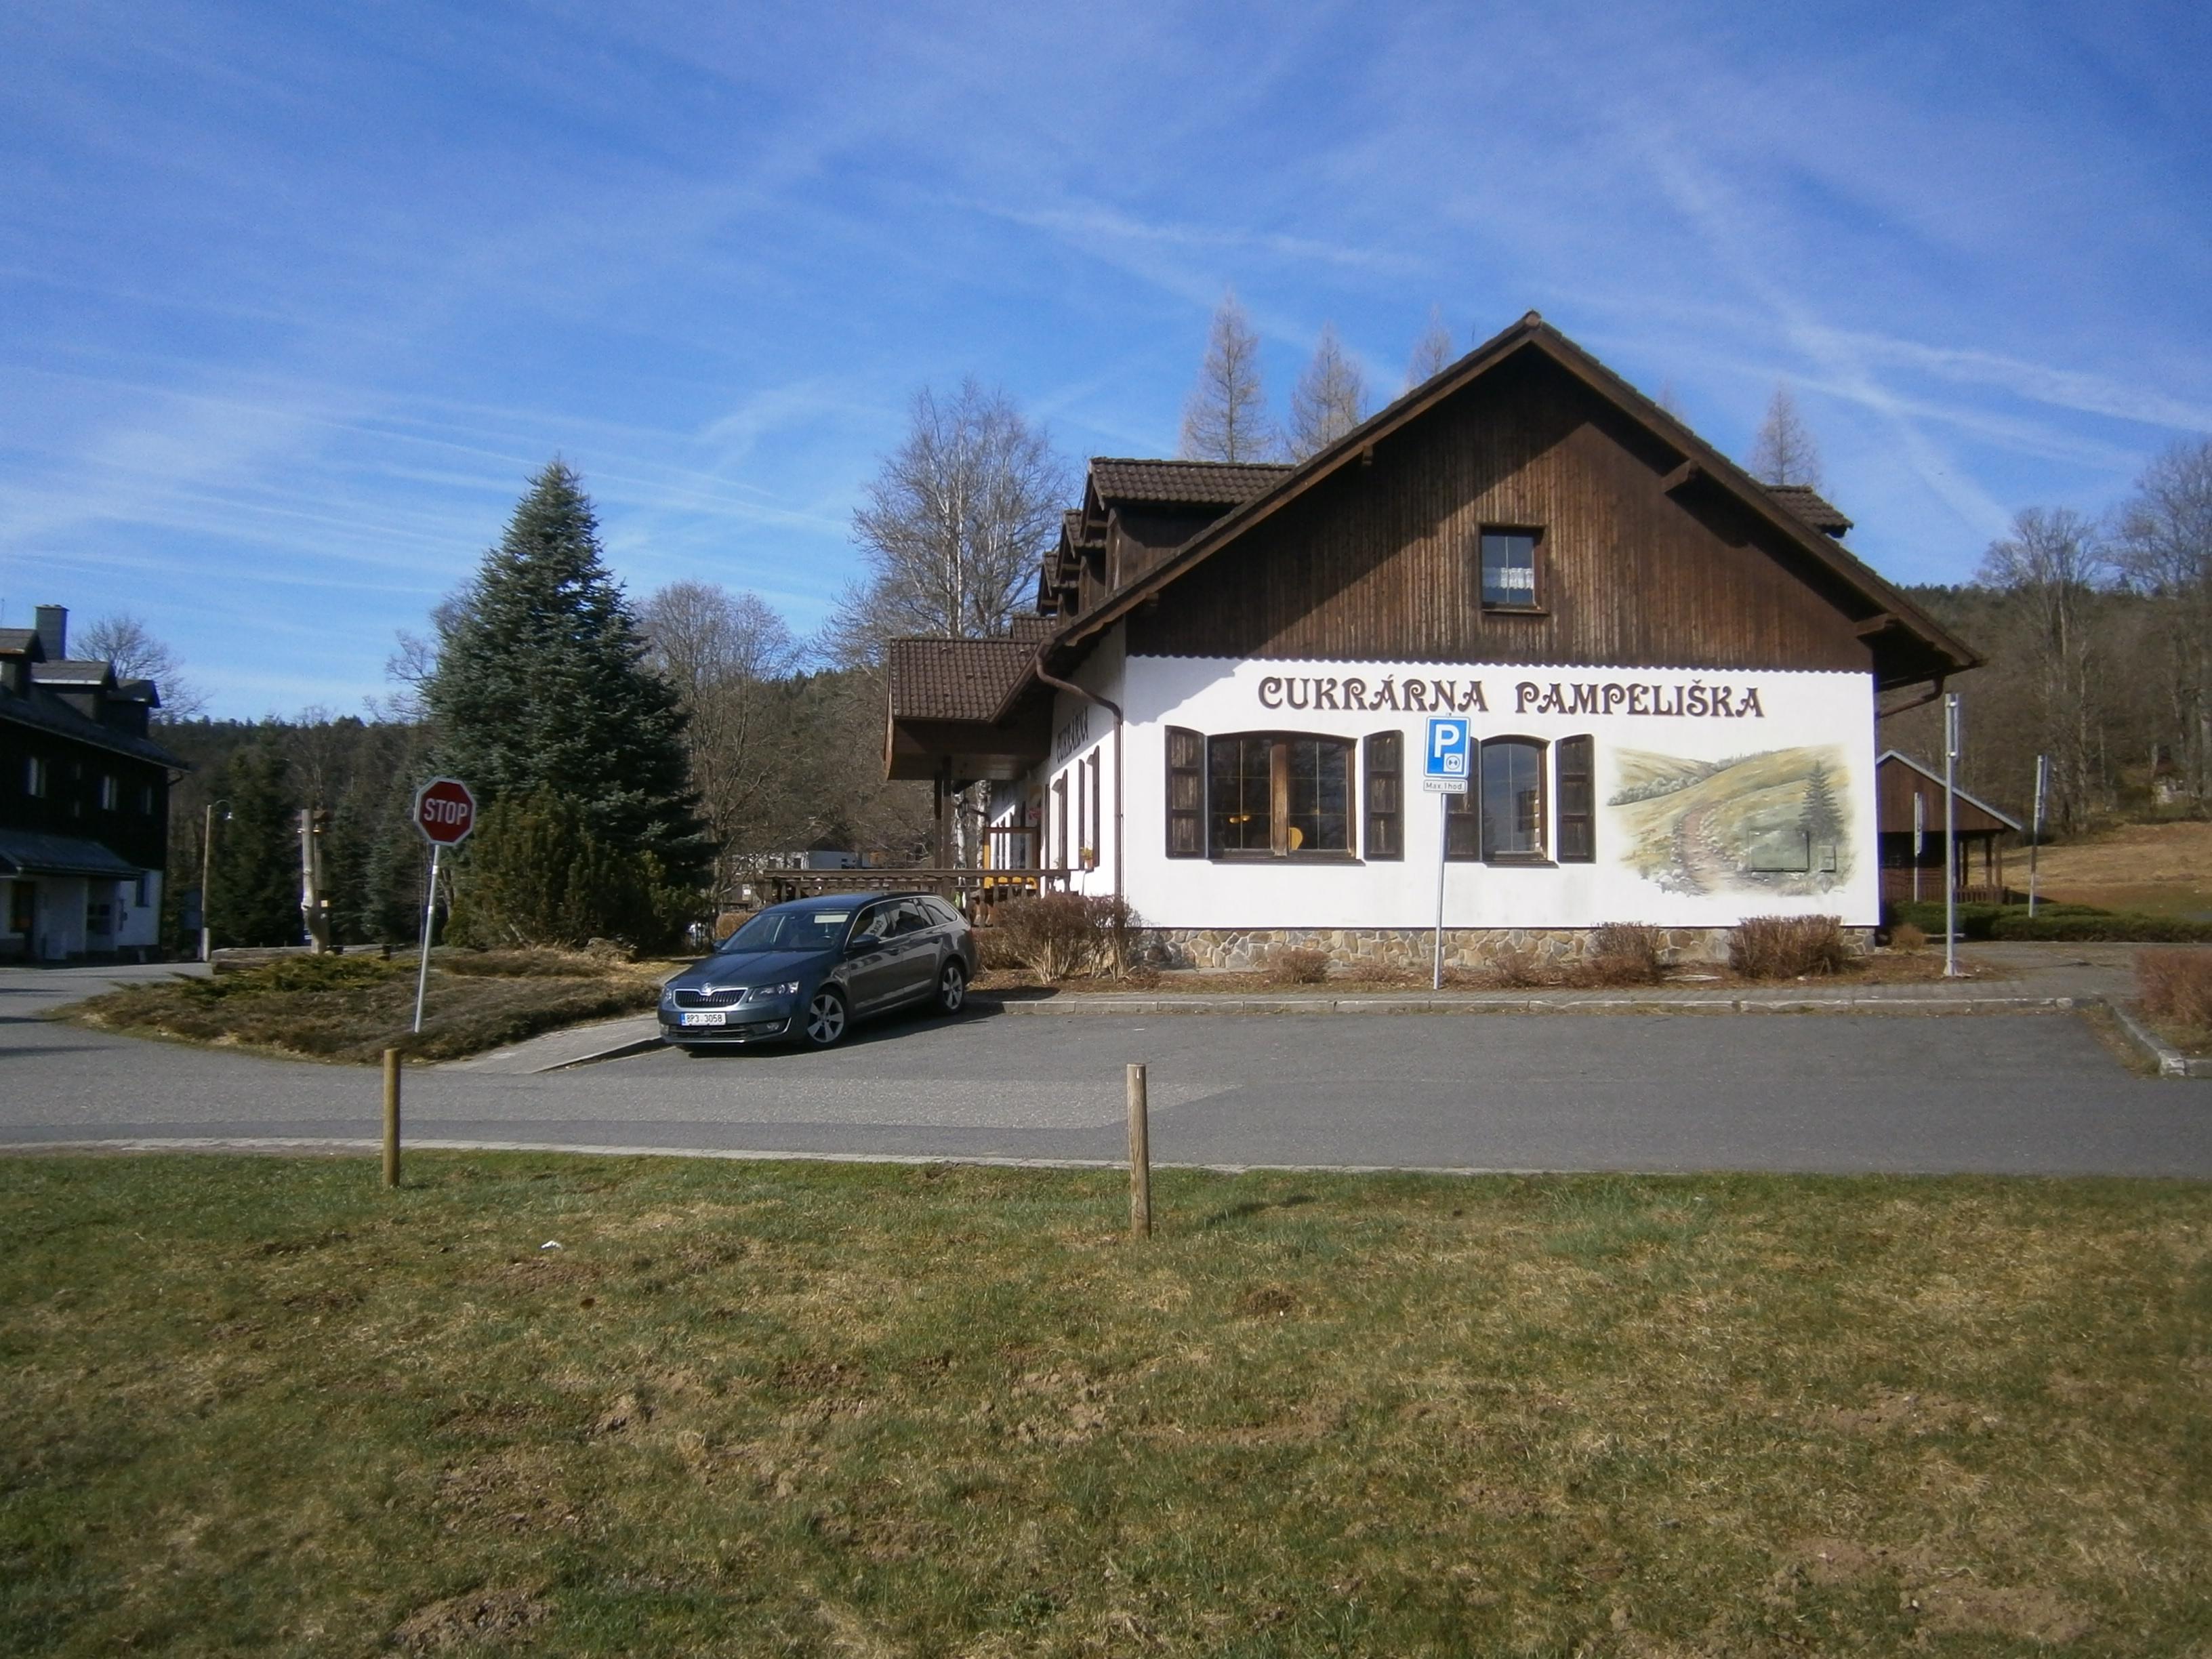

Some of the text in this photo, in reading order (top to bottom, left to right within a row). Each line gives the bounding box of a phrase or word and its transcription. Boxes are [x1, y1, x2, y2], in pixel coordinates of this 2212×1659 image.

[1258, 674, 1765, 718] CUKRÁRNA PAMPELIŠKA
[1434, 724, 1460, 758] P
[424, 798, 468, 825] STOP
[704, 1014, 722, 1023] 3058
